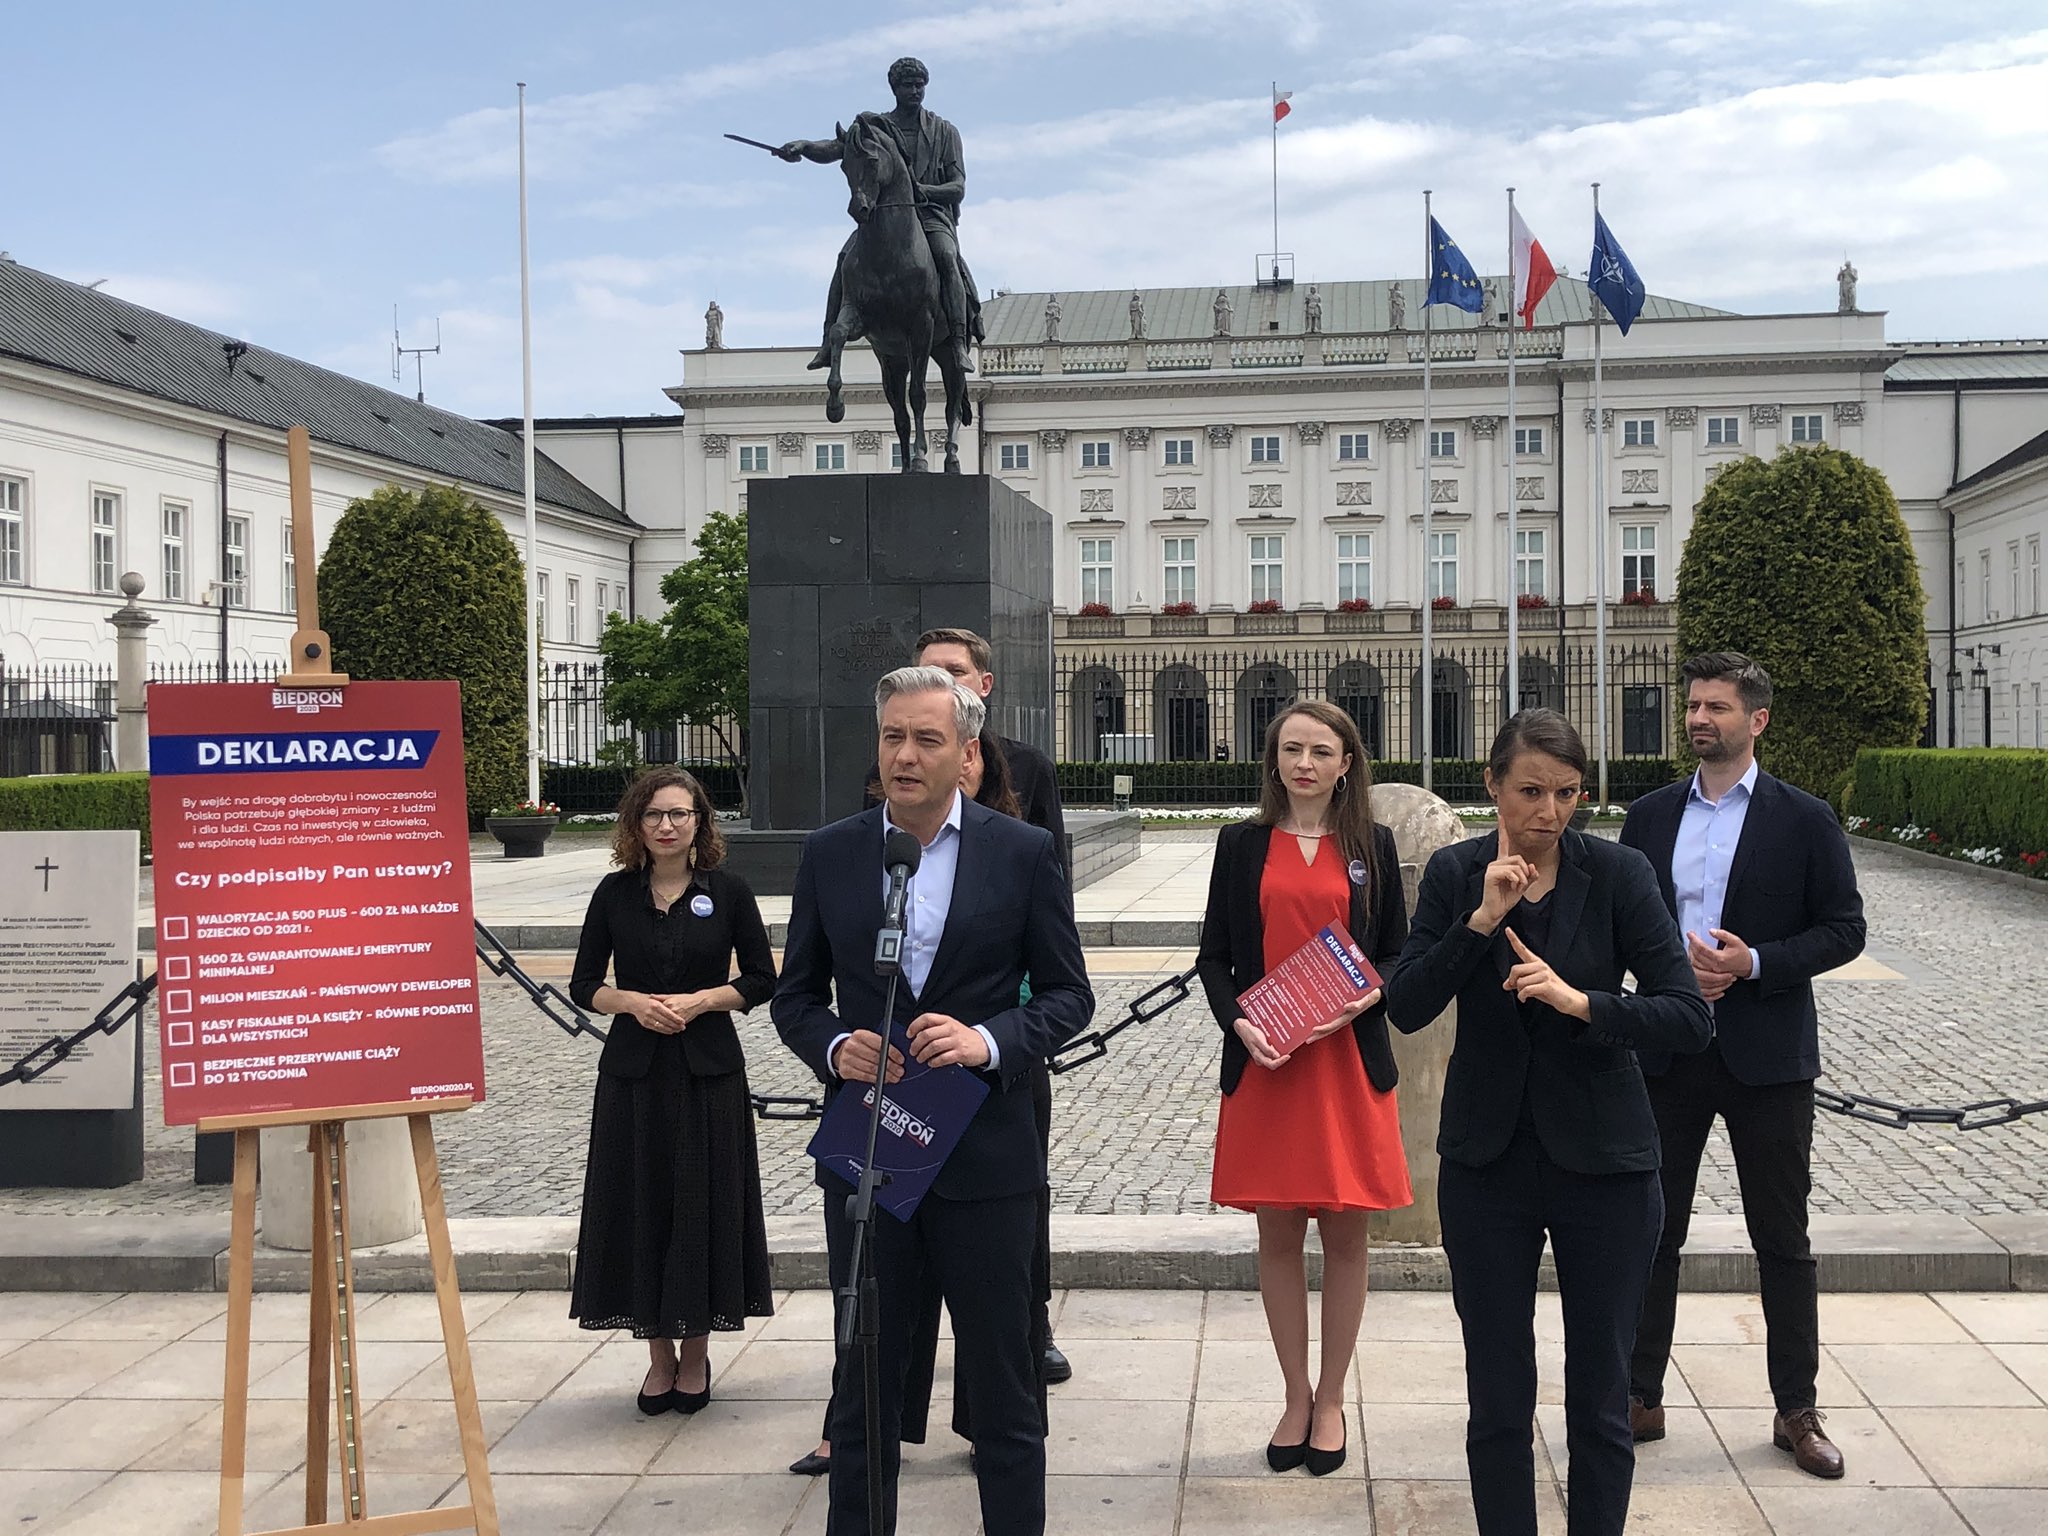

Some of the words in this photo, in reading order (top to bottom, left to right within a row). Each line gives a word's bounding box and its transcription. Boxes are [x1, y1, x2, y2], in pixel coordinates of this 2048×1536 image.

[273, 688, 343, 705] BIEDROŃ
[299, 705, 318, 713] 2020
[198, 738, 419, 765] DEKLARACJA
[182, 797, 197, 809] By
[200, 794, 232, 808] wejść
[234, 797, 250, 805] na
[252, 795, 287, 806] drogę
[289, 793, 348, 805] dobrobytu
[356, 789, 437, 801] nowoczesności
[185, 811, 221, 821] Polska
[224, 808, 285, 821] potrzebuje
[288, 806, 339, 819] głębokiej
[342, 804, 381, 816] zmiany
[401, 802, 436, 813] ludźmi
[199, 824, 219, 835] dla
[221, 822, 250, 833] ludzi.
[253, 822, 281, 832] Czas
[284, 822, 299, 831] na
[302, 819, 359, 830] inwestycję
[374, 816, 430, 828] człowieka,
[178, 841, 195, 849] we
[198, 837, 257, 850] wspólnotę
[259, 836, 286, 846] ludzi
[288, 833, 334, 846] różnych,
[336, 832, 354, 842] ale
[356, 831, 393, 842] równie
[395, 829, 445, 841] ważnych.
[175, 871, 212, 888] Czy
[218, 866, 327, 888] podpisałby
[333, 863, 369, 880] Pan
[375, 860, 453, 879] ustawy?
[197, 910, 290, 925] WALORYZACJA
[292, 909, 315, 921] 500
[317, 907, 347, 919] PLUS
[359, 906, 383, 917] 600
[385, 905, 399, 916] ZŁ
[401, 904, 418, 914] NA
[420, 901, 459, 913] KAŻDE
[197, 926, 251, 939] DZIECKO
[253, 925, 273, 936] OD
[275, 924, 302, 935] 2021
[304, 925, 312, 933] r.
[198, 953, 228, 965] 1600
[230, 952, 245, 963] ZŁ
[247, 945, 362, 962] GWARANTOWANEJ
[364, 941, 432, 956] EMERYTURY
[1325, 934, 1365, 988] DEKLARACJA
[199, 964, 275, 978] MINIMALNEJ
[200, 992, 244, 1005] MILION
[246, 987, 307, 1002] MIESZKAŃ
[319, 982, 399, 997] PAŃSTWOWY
[401, 978, 472, 992] DEWELOPER
[201, 1018, 235, 1031] KASY
[237, 1014, 294, 1029] FISKALNE
[296, 1013, 321, 1025] DLA
[323, 1009, 363, 1024] KSIĘŻY
[375, 1005, 420, 1020] RÓWNE
[422, 1003, 474, 1017] PODATKI
[202, 1033, 228, 1045] DLA
[230, 1028, 309, 1043] WSZYSTKICH
[203, 1056, 276, 1072] BEZPIECZNE
[278, 1050, 363, 1066] PRZERYWANIE
[365, 1046, 401, 1061] CIĄŻY
[204, 1073, 225, 1085] DO
[227, 1072, 240, 1083] 12
[242, 1066, 308, 1082] TYGODNIA
[863, 1089, 935, 1146] BEDROŃ
[883, 1118, 903, 1135] 2020
